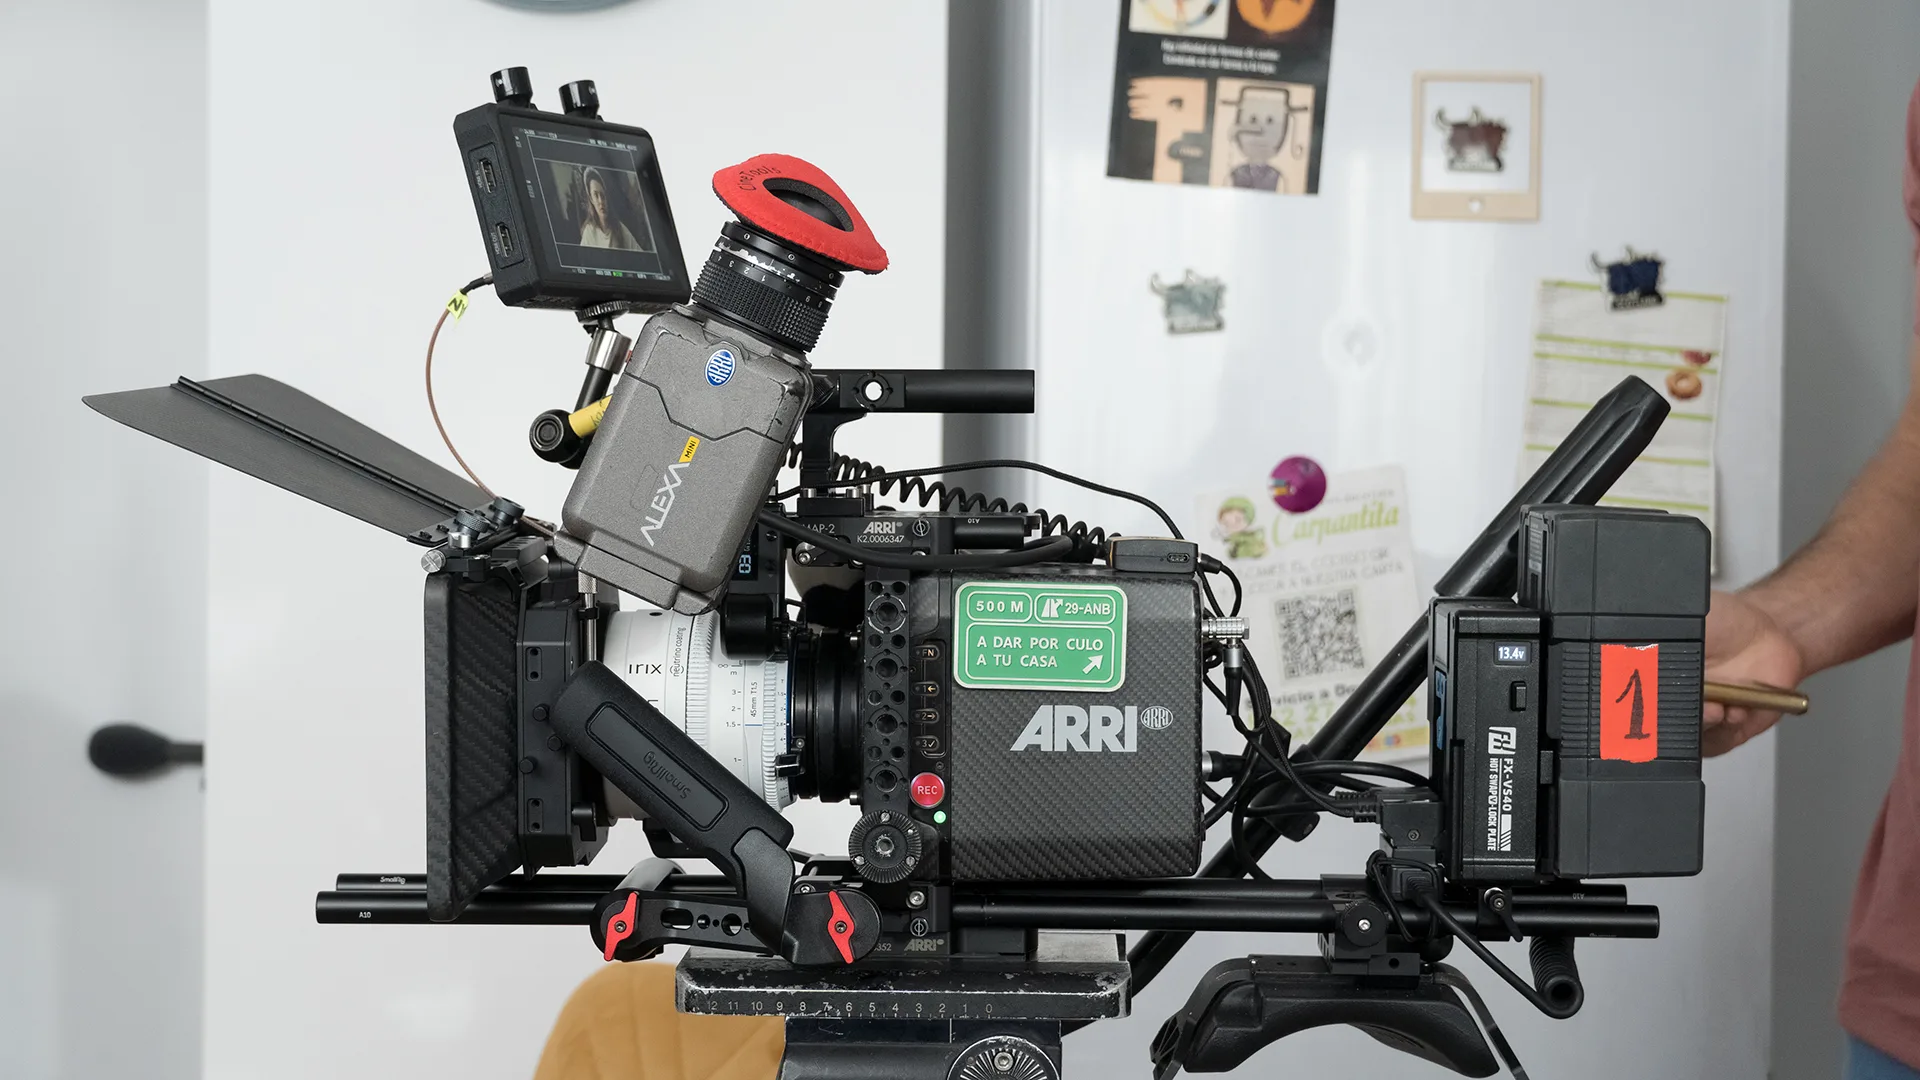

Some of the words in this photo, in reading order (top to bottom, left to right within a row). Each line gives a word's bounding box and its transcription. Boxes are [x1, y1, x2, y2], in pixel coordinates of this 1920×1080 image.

[705, 350, 735, 386] ARRI
[684, 439, 697, 459] MINI
[640, 462, 690, 547] ALEXA
[863, 521, 896, 534] ARRI
[857, 535, 905, 544] K2.0006347
[976, 601, 1005, 612] 500
[1011, 601, 1024, 613] M
[1065, 603, 1111, 615] 29-ANB
[977, 636, 987, 648] A
[993, 637, 1022, 649] DAR
[1030, 637, 1059, 650] POR
[1066, 639, 1104, 651] CULO
[1498, 646, 1525, 660] 13.4v
[976, 654, 987, 666] A
[993, 655, 1012, 666] TU
[1020, 655, 1058, 668] CASA
[1616, 669, 1650, 740] 1
[922, 712, 928, 720] 2
[1141, 706, 1173, 730] ARRI
[1009, 704, 1138, 752] ARRI
[922, 739, 928, 747] 3
[1489, 758, 1498, 773] HOT
[643, 752, 691, 799] SmallRig
[917, 786, 938, 795] REC
[1502, 758, 1513, 811] FX-VS40
[1487, 828, 1497, 851] PLATE
[875, 943, 892, 952] 352
[904, 939, 937, 951] ARRI
[707, 1001, 718, 1010] 12
[728, 1001, 739, 1010] 11
[751, 1001, 763, 1011] 10
[776, 1001, 783, 1011] 9
[799, 1001, 806, 1011] 8
[846, 1002, 853, 1012] 6
[869, 1002, 876, 1012] 5
[892, 1002, 899, 1012] 4
[915, 1003, 922, 1013] 3
[939, 1003, 946, 1013] 2
[985, 1003, 993, 1013] 0
